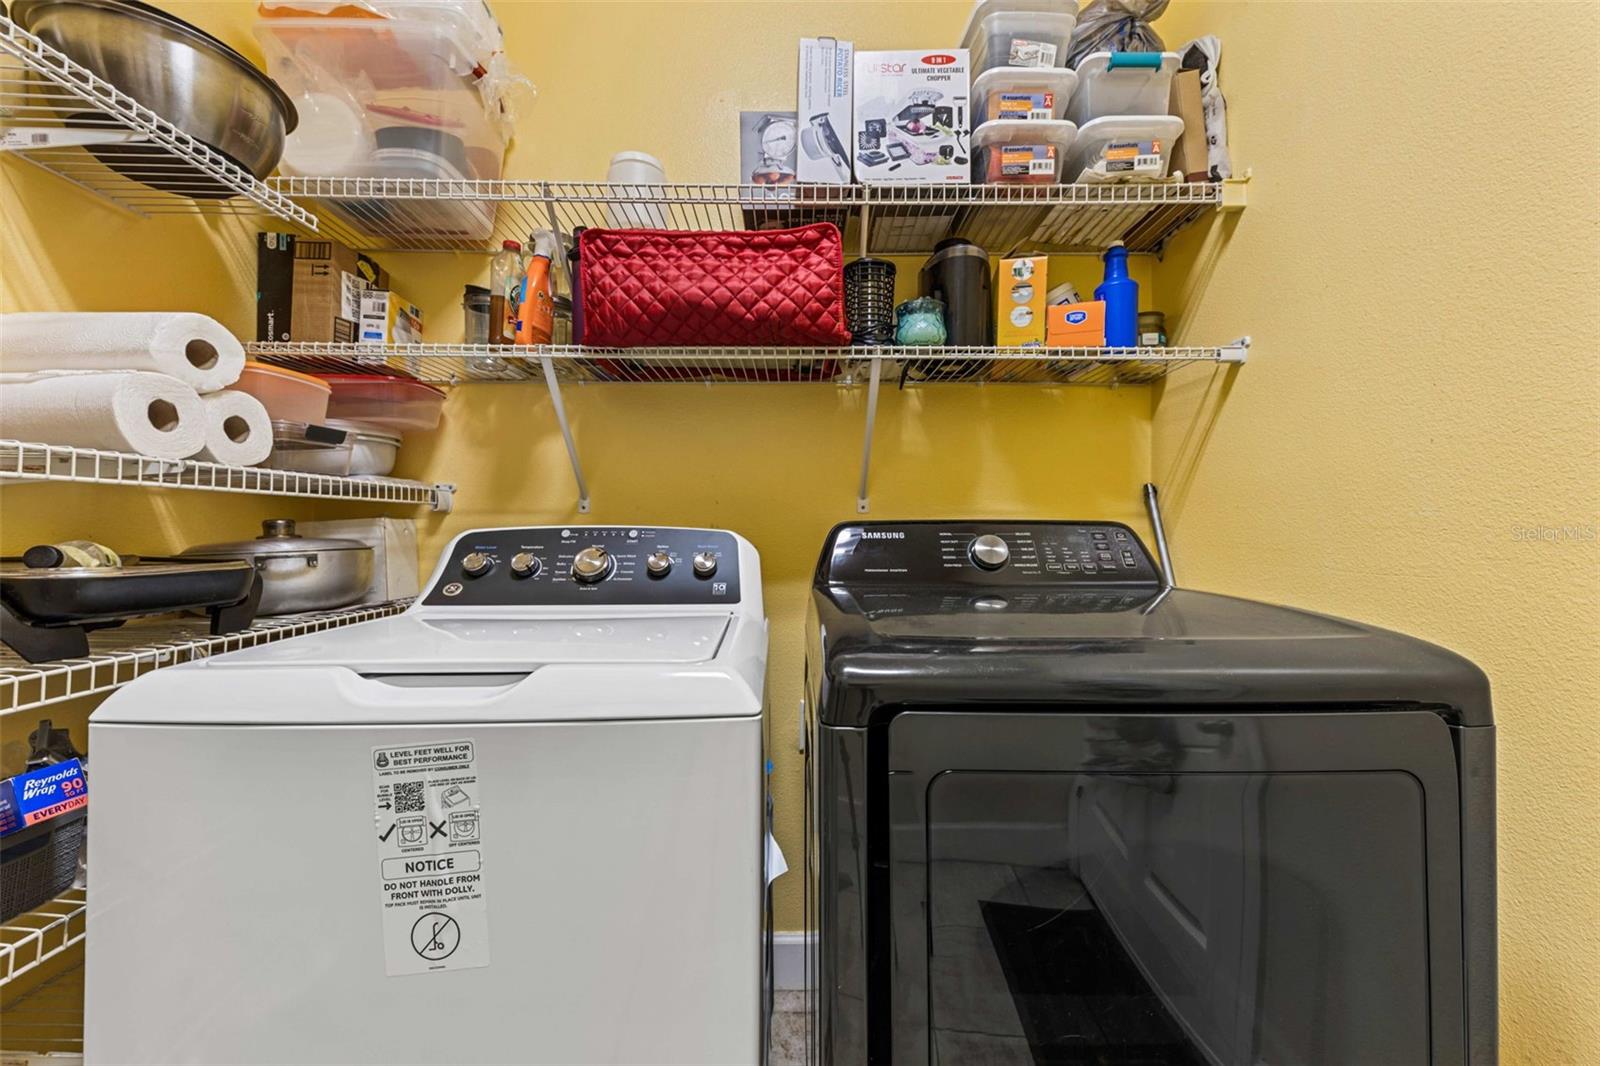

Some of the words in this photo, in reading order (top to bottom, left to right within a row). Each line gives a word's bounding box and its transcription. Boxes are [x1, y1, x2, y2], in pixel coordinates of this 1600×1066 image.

[413, 753, 468, 764] PERFORMANCE
[24, 767, 78, 791] Reynolds
[61, 778, 83, 792] 90
[23, 784, 56, 800] Wrap
[33, 796, 85, 820] EVERYDAY
[405, 858, 454, 873] NOTICE
[384, 883, 397, 891] DO
[399, 881, 417, 890] NOT
[420, 877, 454, 888] HANDLE
[456, 874, 480, 884] FROM
[391, 890, 419, 900] FRONT
[445, 885, 475, 896] DOLLY.
